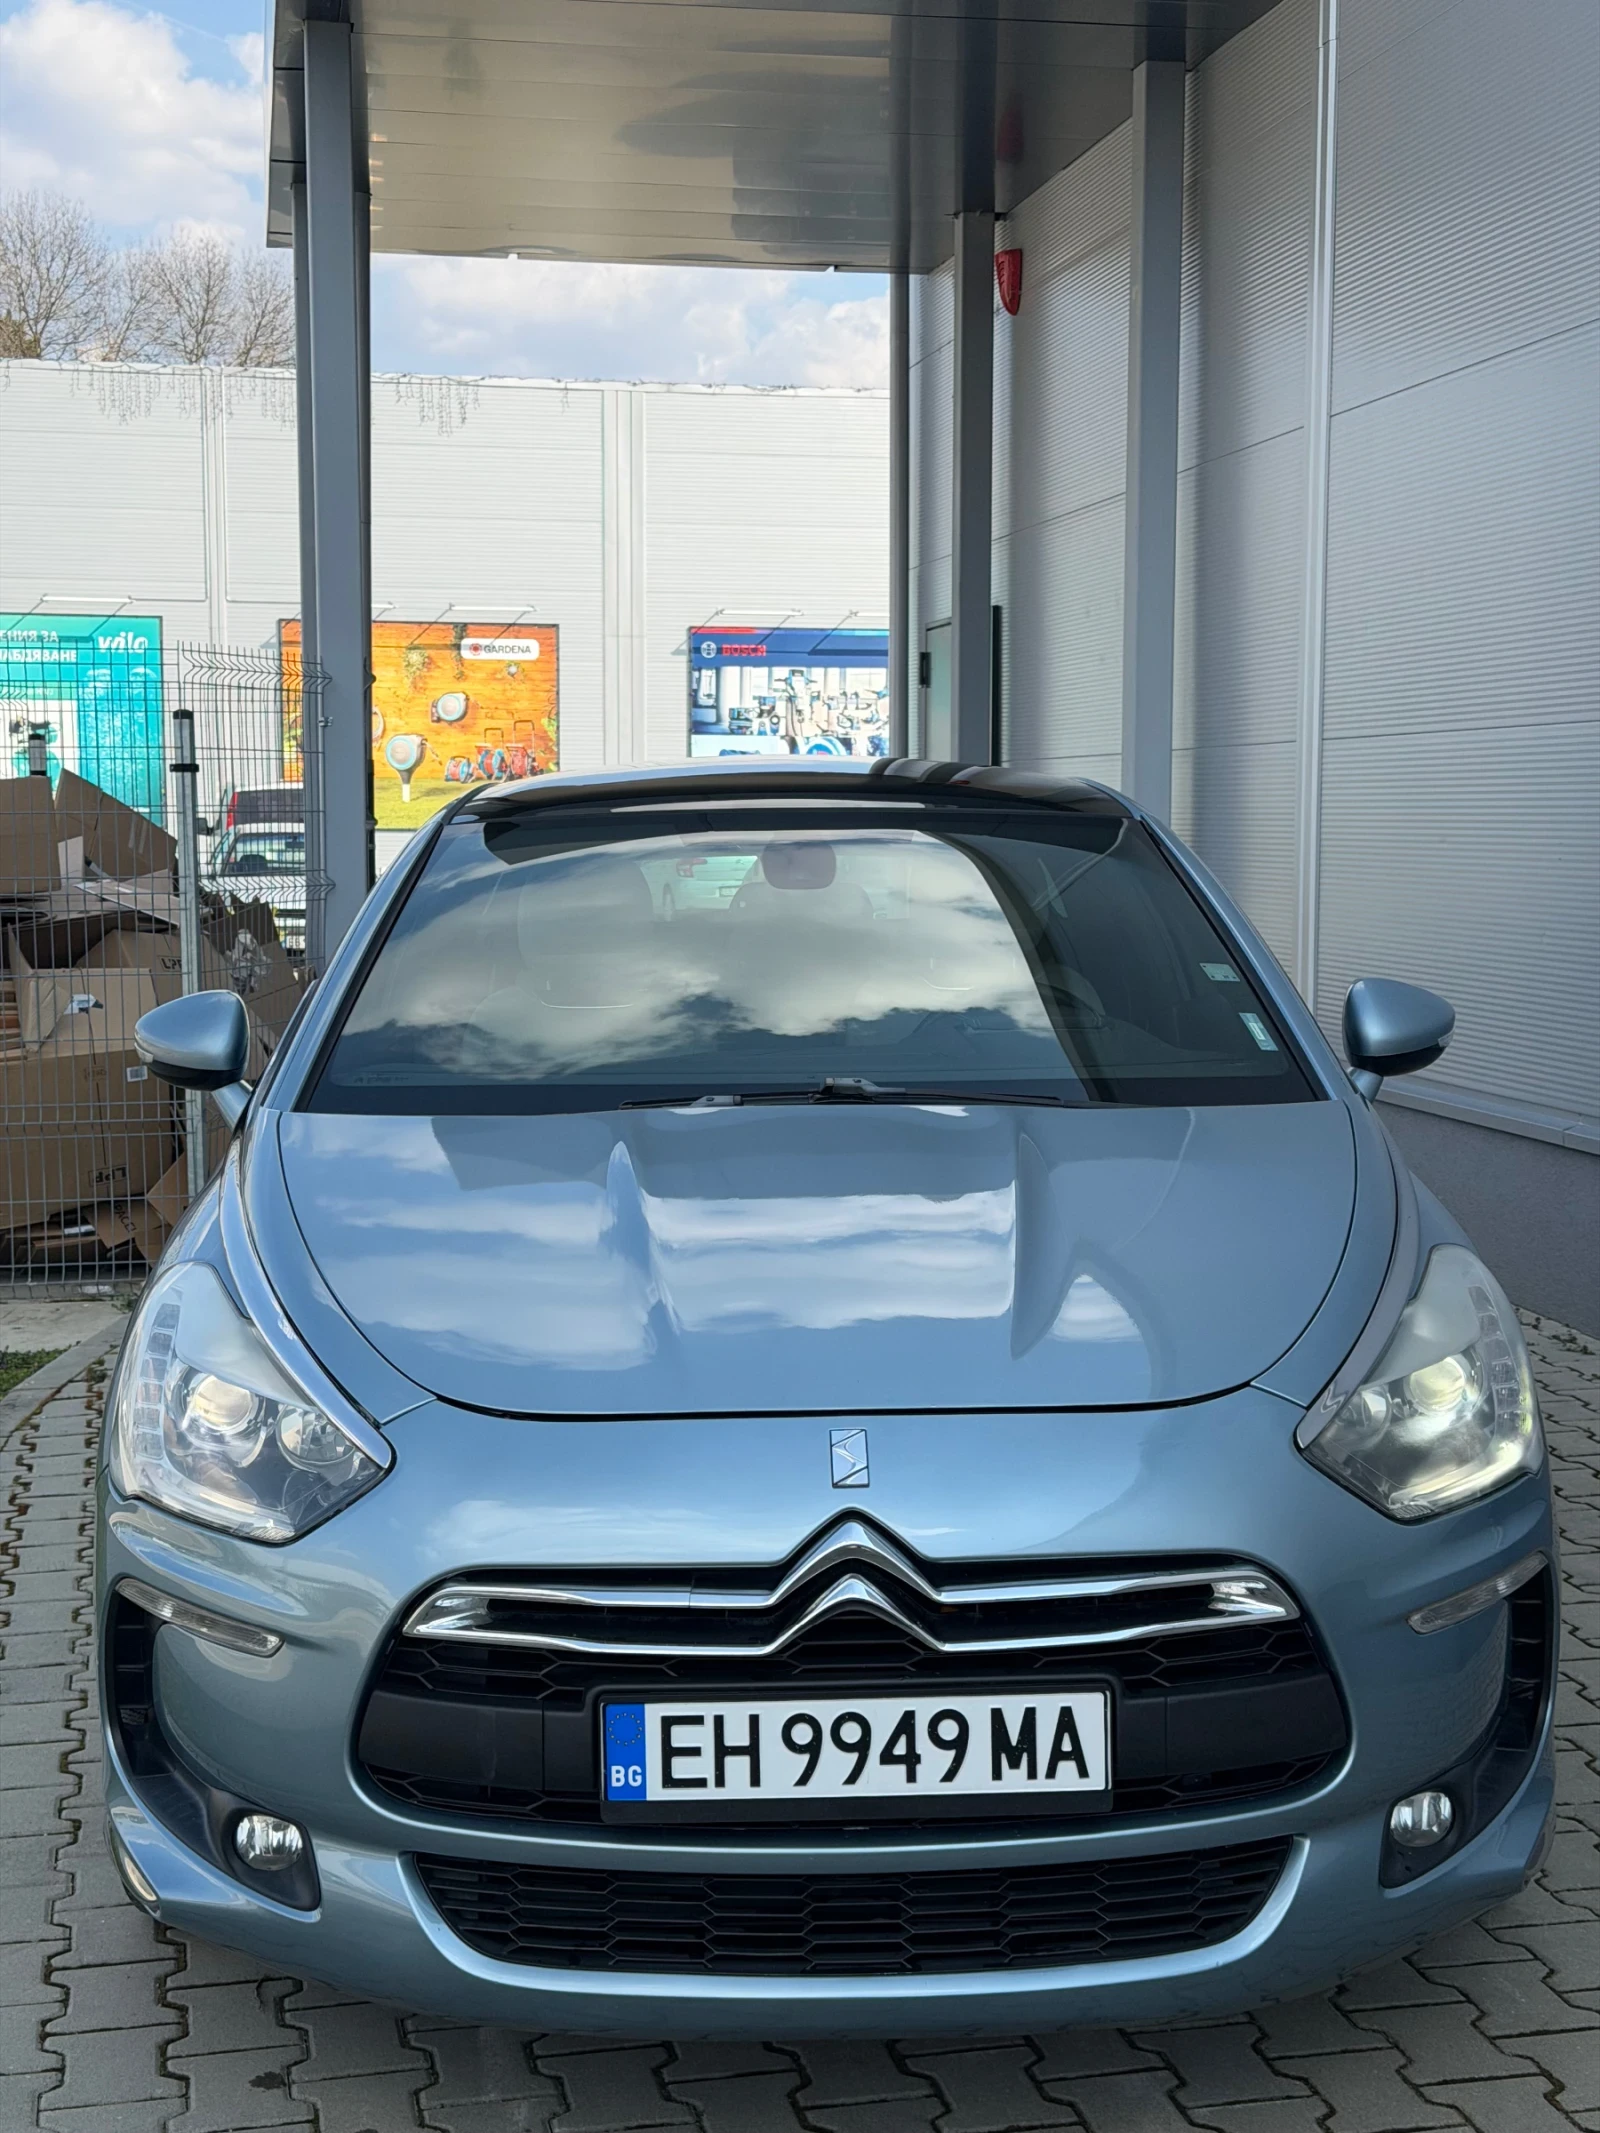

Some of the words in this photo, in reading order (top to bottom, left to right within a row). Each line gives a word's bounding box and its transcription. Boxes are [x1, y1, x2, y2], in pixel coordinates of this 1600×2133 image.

[41, 631, 59, 642] ЗА
[98, 632, 149, 653] wilo
[483, 645, 531, 654] GARDENA
[722, 644, 766, 656] BOSCH
[660, 1713, 761, 1789] EH
[781, 1708, 970, 1787] 9949
[991, 1705, 1090, 1782] MA
[611, 1766, 643, 1788] BG
